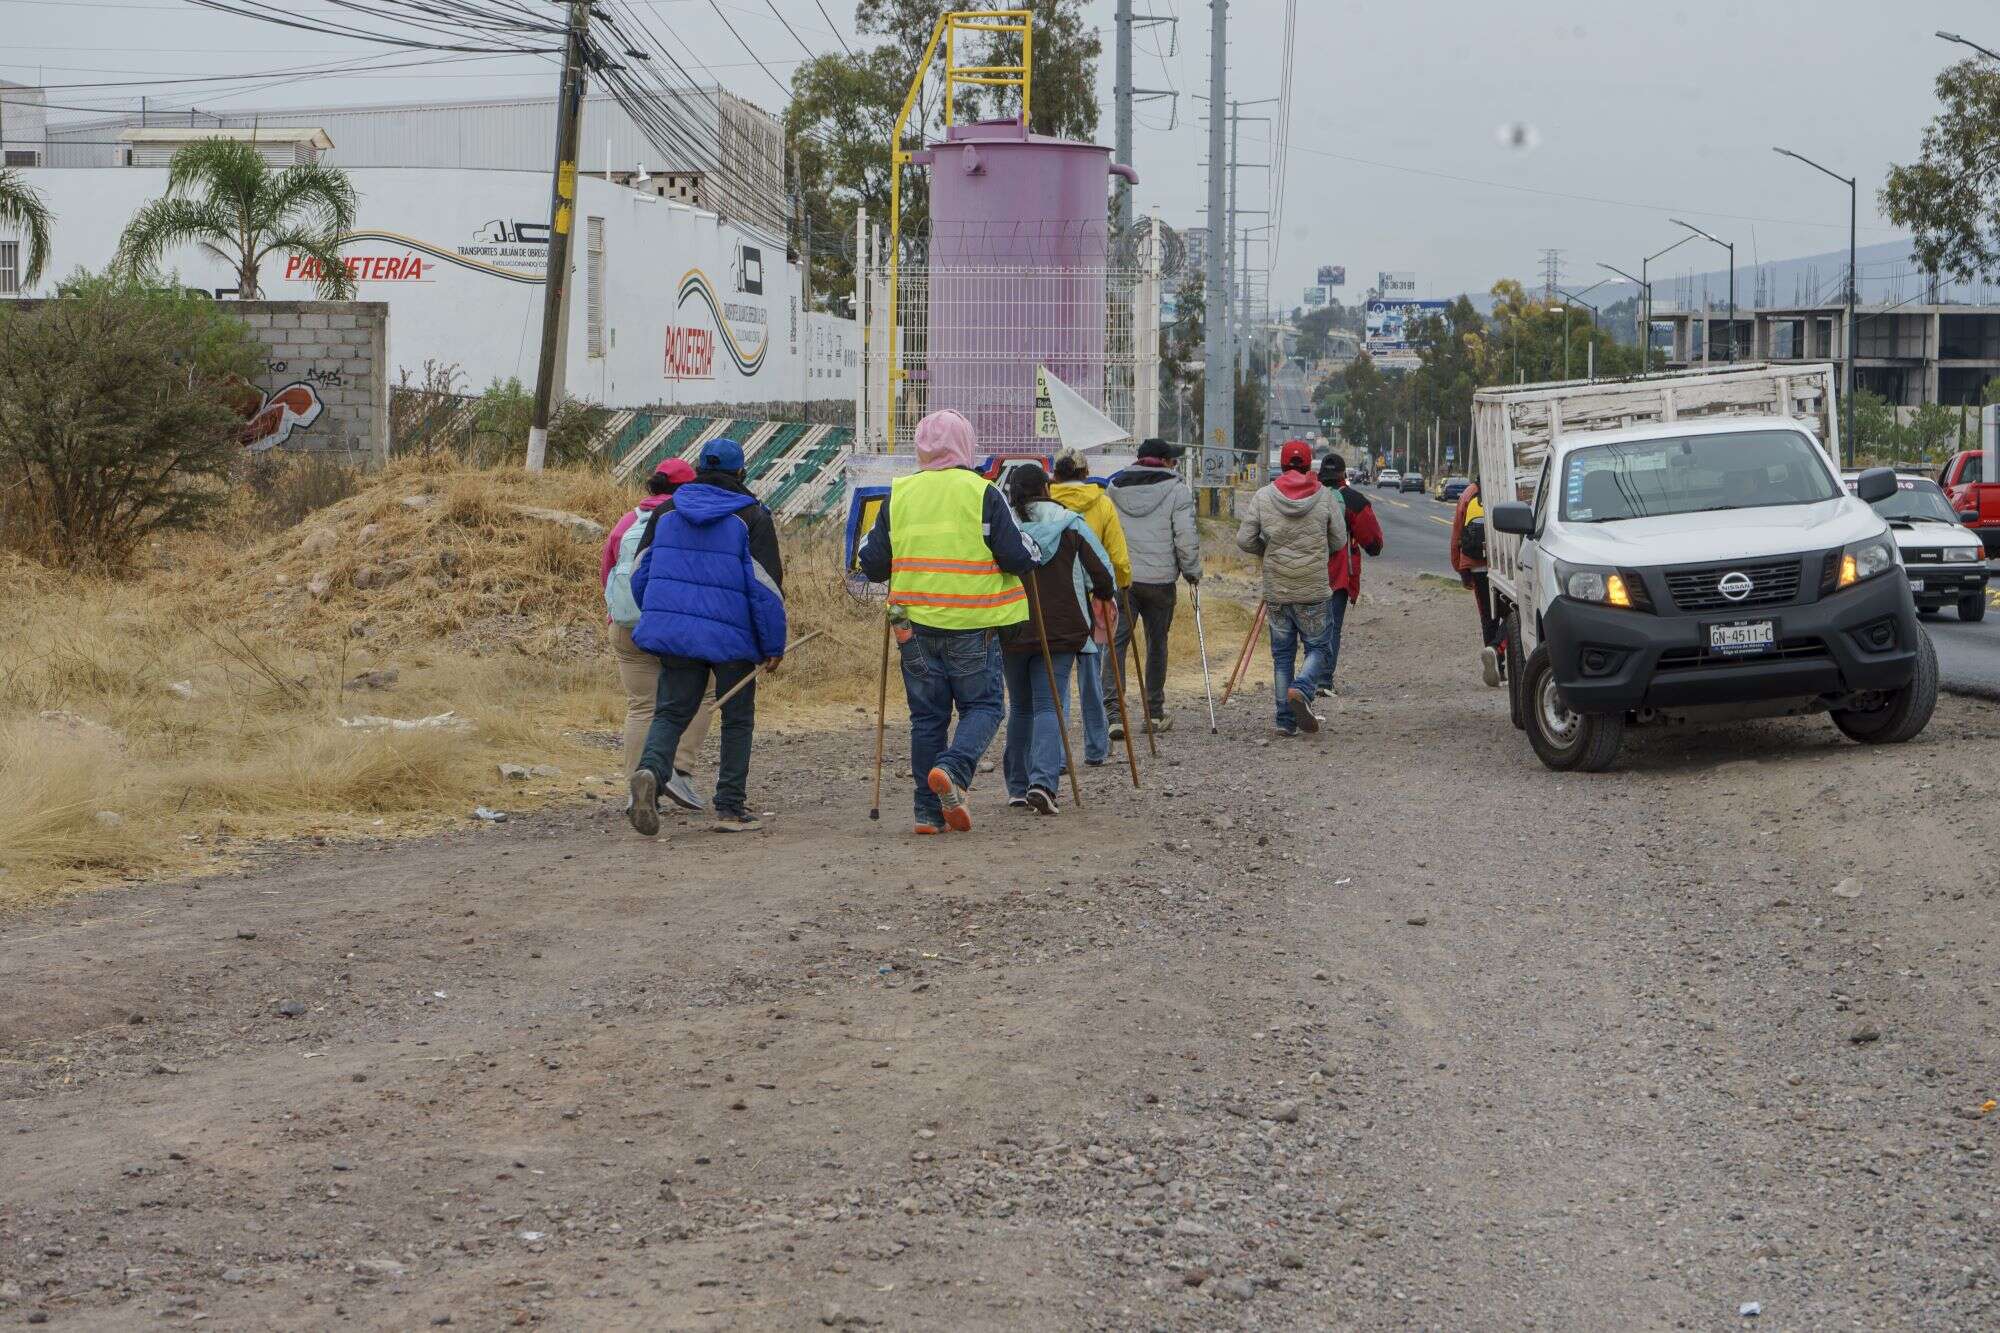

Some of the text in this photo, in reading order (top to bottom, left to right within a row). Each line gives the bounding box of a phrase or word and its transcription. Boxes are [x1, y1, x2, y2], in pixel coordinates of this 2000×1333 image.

[457, 246, 498, 256] TRANSPORTES
[285, 251, 421, 280] PAETERÍA
[1721, 583, 1750, 591] NISSAN
[1712, 627, 1772, 645] GN-4511-C
